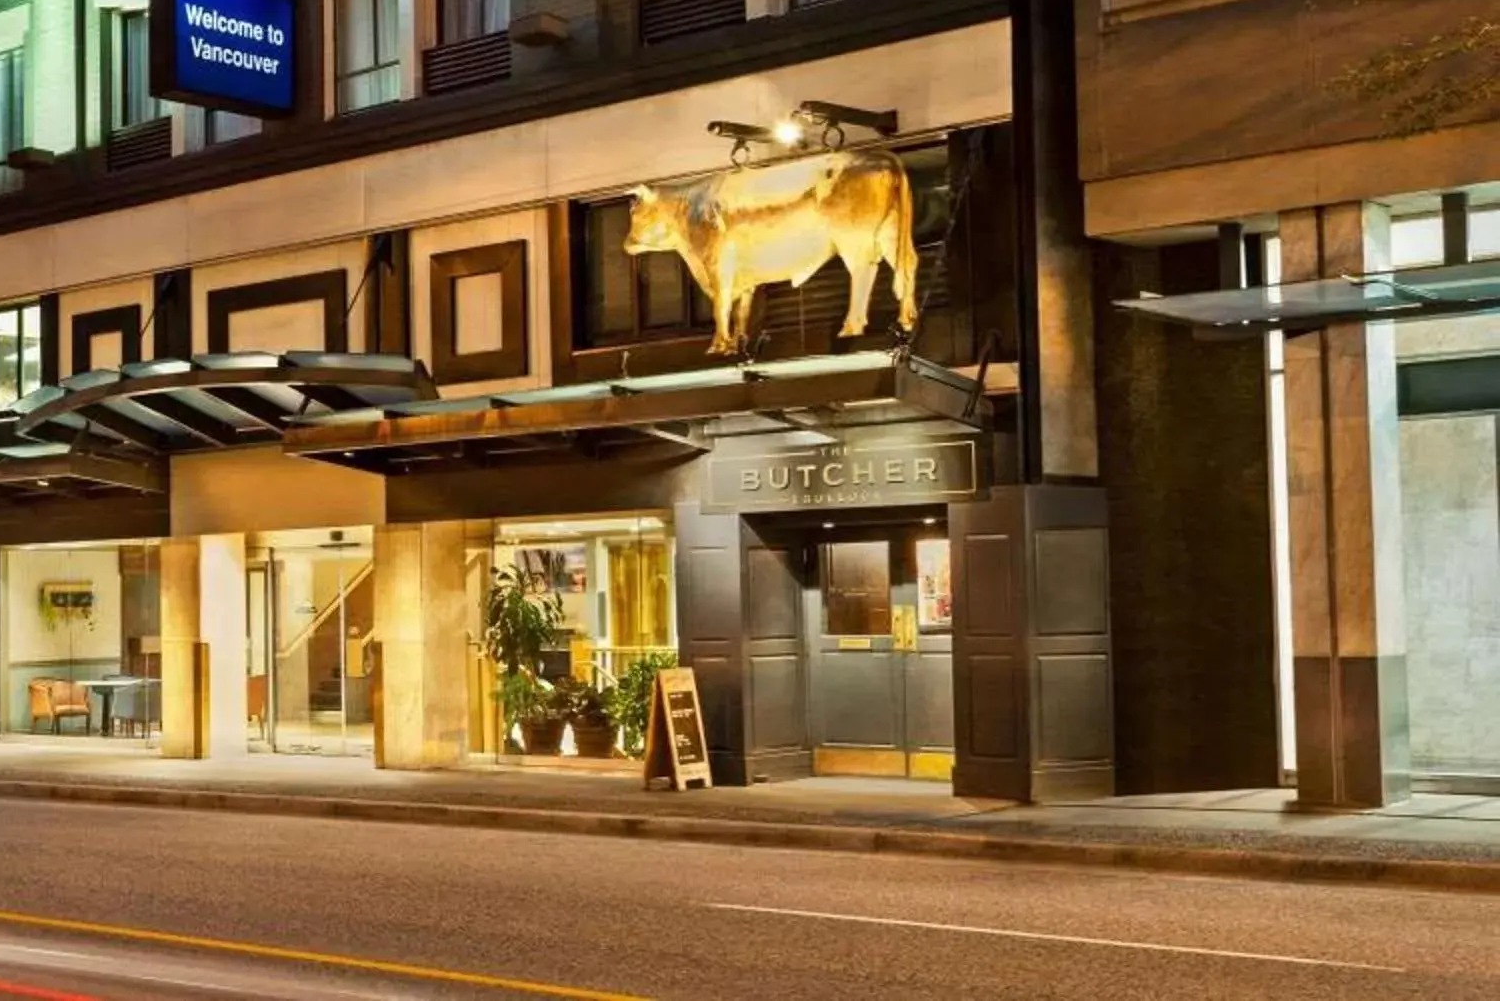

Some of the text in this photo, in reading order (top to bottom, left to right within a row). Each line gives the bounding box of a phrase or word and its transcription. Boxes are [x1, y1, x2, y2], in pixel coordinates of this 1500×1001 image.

[185, 2, 285, 46] Welcome to
[190, 36, 280, 74] Vancouver
[739, 457, 939, 492] BUTCHER
